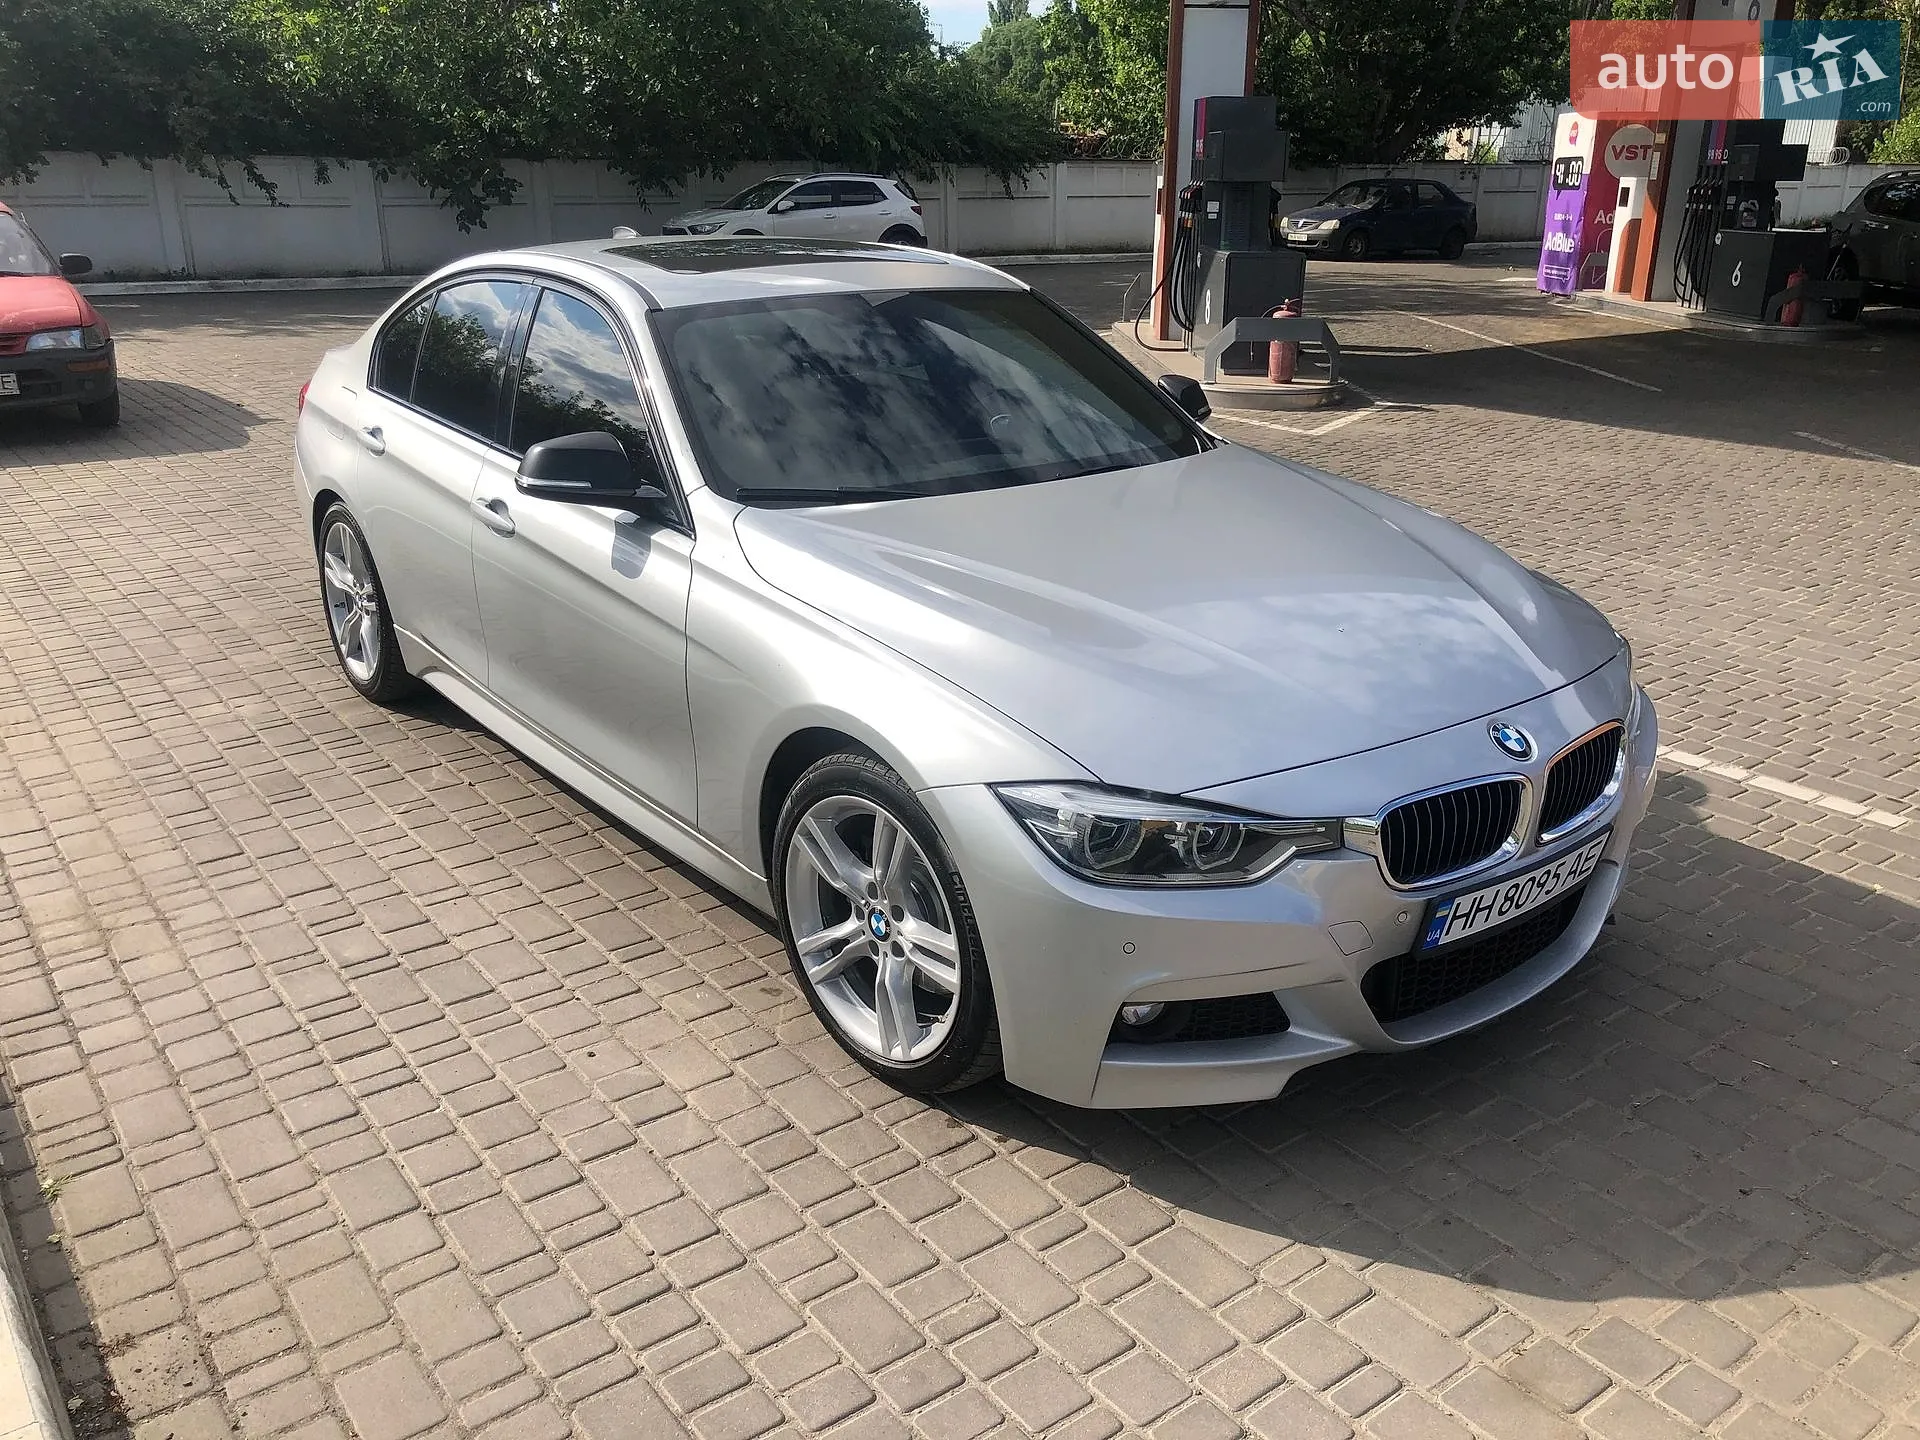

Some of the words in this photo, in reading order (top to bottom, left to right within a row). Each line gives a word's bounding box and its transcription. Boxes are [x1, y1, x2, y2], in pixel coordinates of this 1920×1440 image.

[1611, 144, 1653, 161] VST
[1722, 149, 1729, 160] D
[1556, 161, 1582, 186] 41.00
[1544, 231, 1575, 253] AdBlue
[1731, 260, 1742, 287] 6
[1205, 288, 1211, 325] 8
[1444, 889, 1500, 936] HH
[1498, 861, 1566, 916] 8095
[1561, 840, 1603, 888] AE
[1426, 929, 1441, 942] UA
